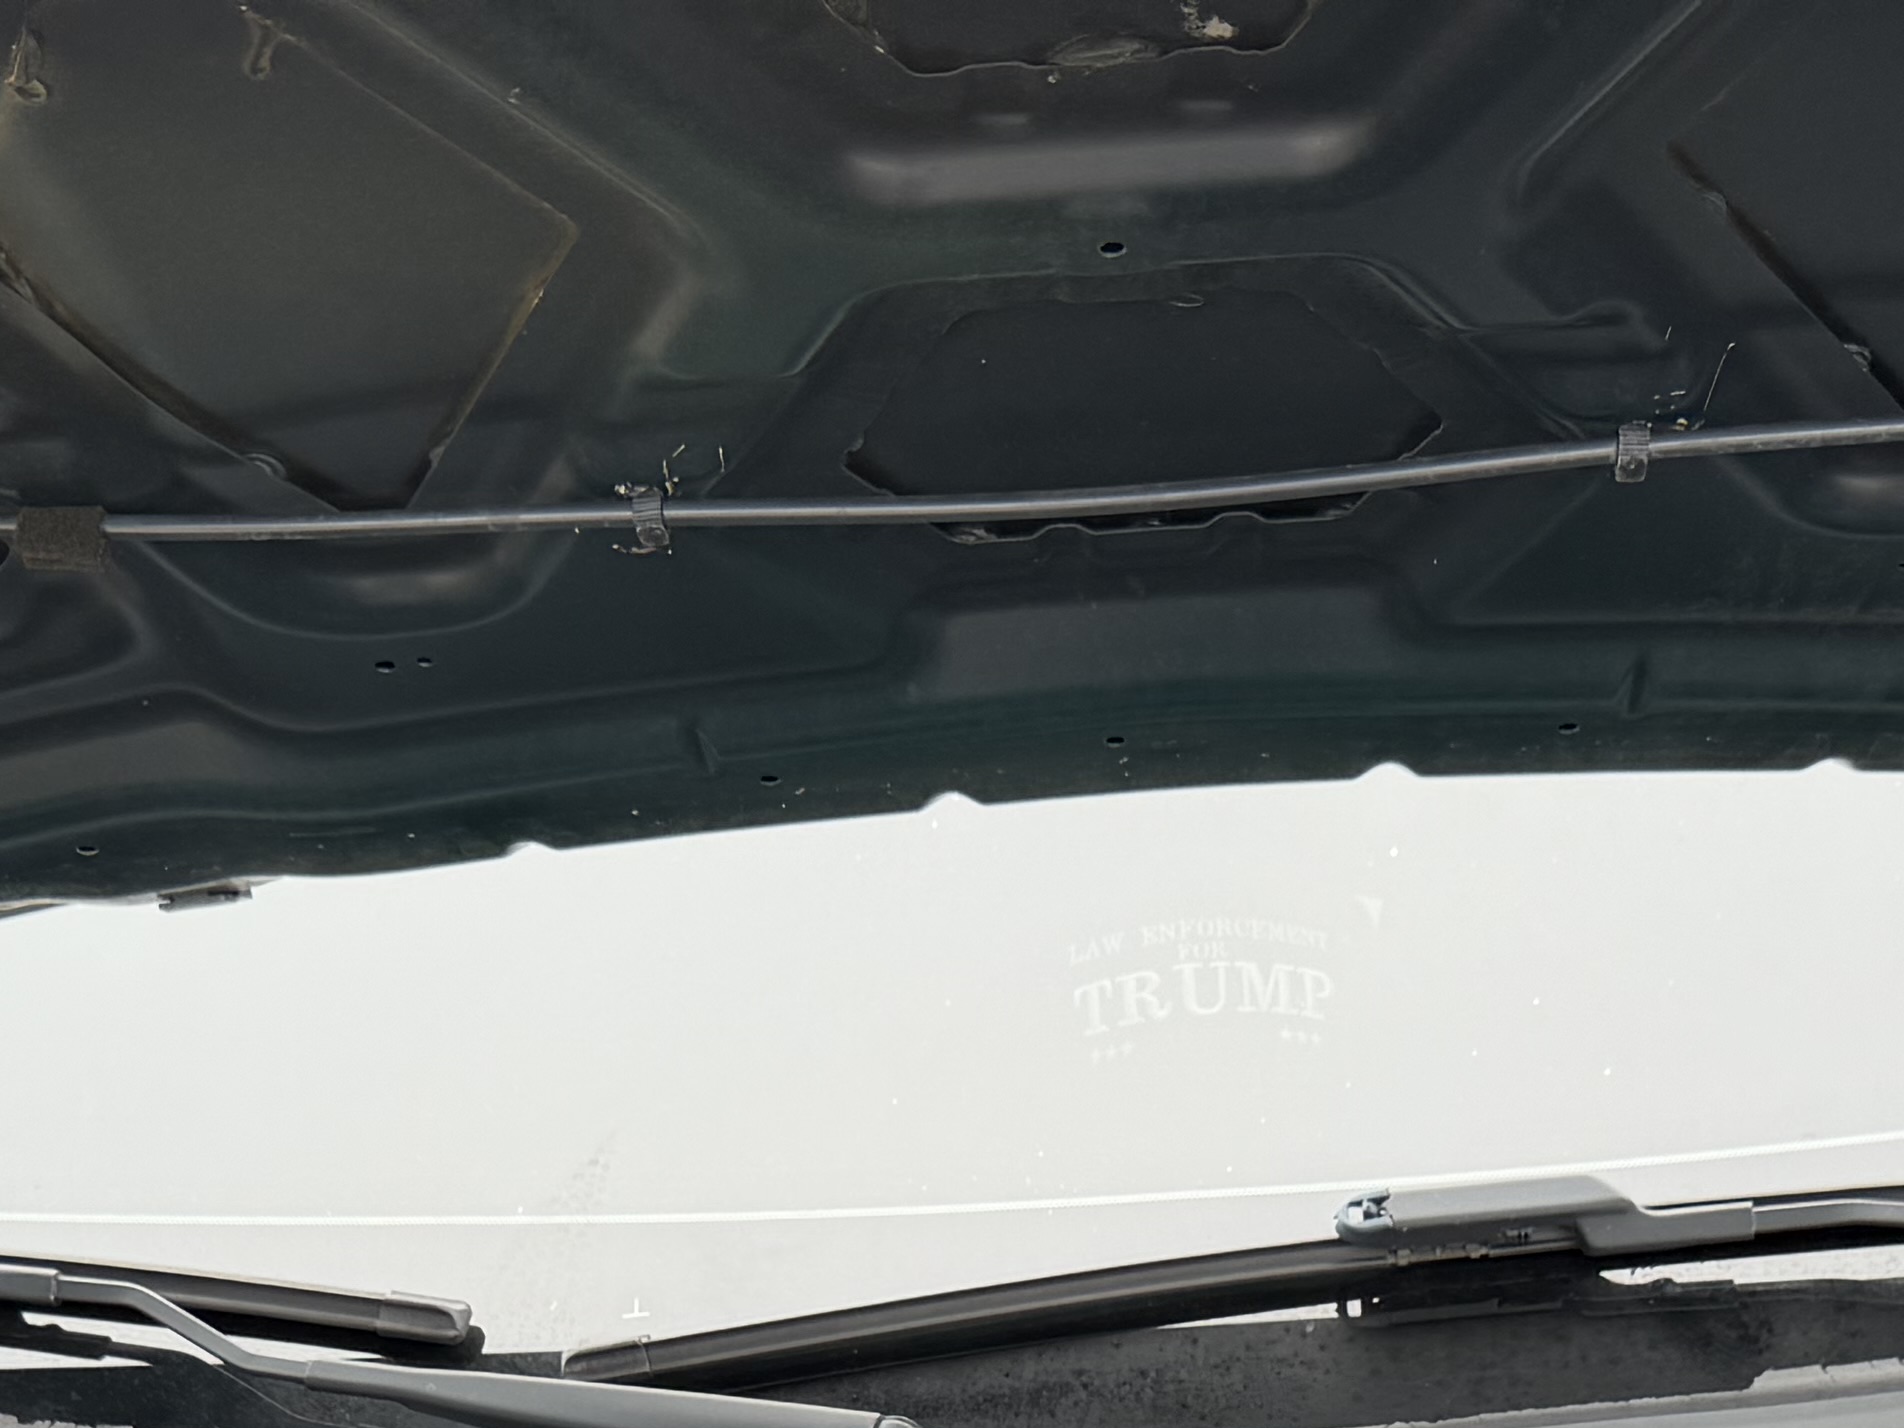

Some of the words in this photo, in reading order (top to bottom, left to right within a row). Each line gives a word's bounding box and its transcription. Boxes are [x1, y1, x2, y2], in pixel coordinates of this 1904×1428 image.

[1067, 930, 1126, 967] LAW
[1138, 915, 1330, 953] ENFORCEMENT
[1177, 939, 1230, 962] FOR
[1072, 959, 1335, 1037] TRUMP
